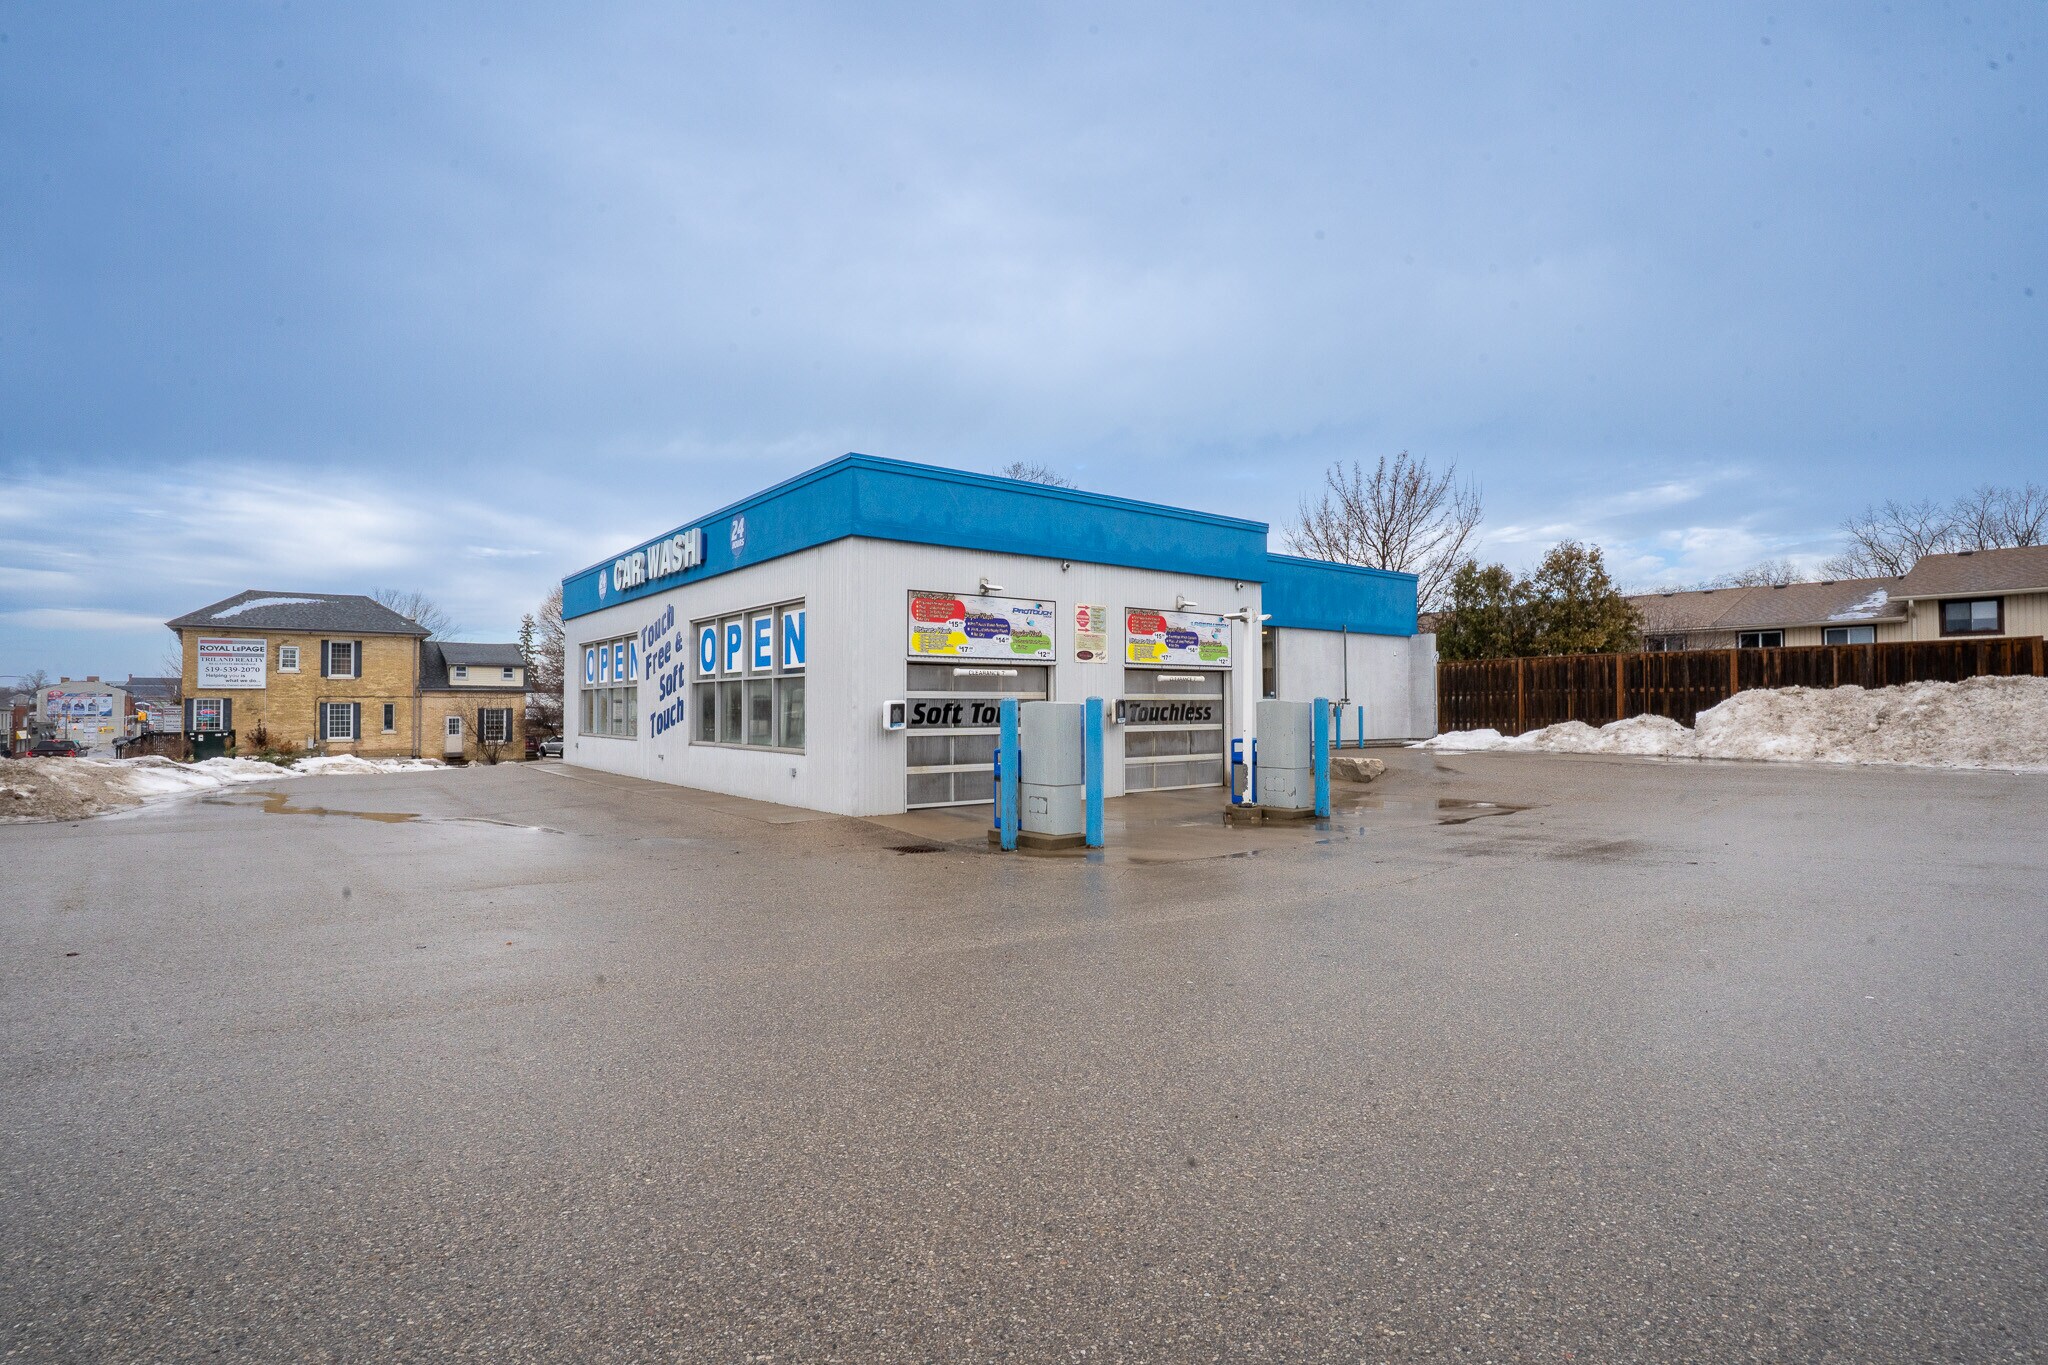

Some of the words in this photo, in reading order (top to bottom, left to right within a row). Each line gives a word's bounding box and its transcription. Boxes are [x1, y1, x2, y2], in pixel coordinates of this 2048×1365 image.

[731, 517, 745, 541] 24
[613, 551, 646, 592] CAR
[646, 527, 702, 580] WASH
[640, 603, 675, 654] Touch
[700, 611, 806, 673] OPEN
[587, 642, 638, 682] OPEN
[645, 640, 672, 681] Free
[675, 631, 683, 653] &
[659, 661, 685, 702] Soft
[649, 696, 684, 739] Touch
[911, 702, 963, 725] Soft
[1129, 703, 1212, 722] Touchless
